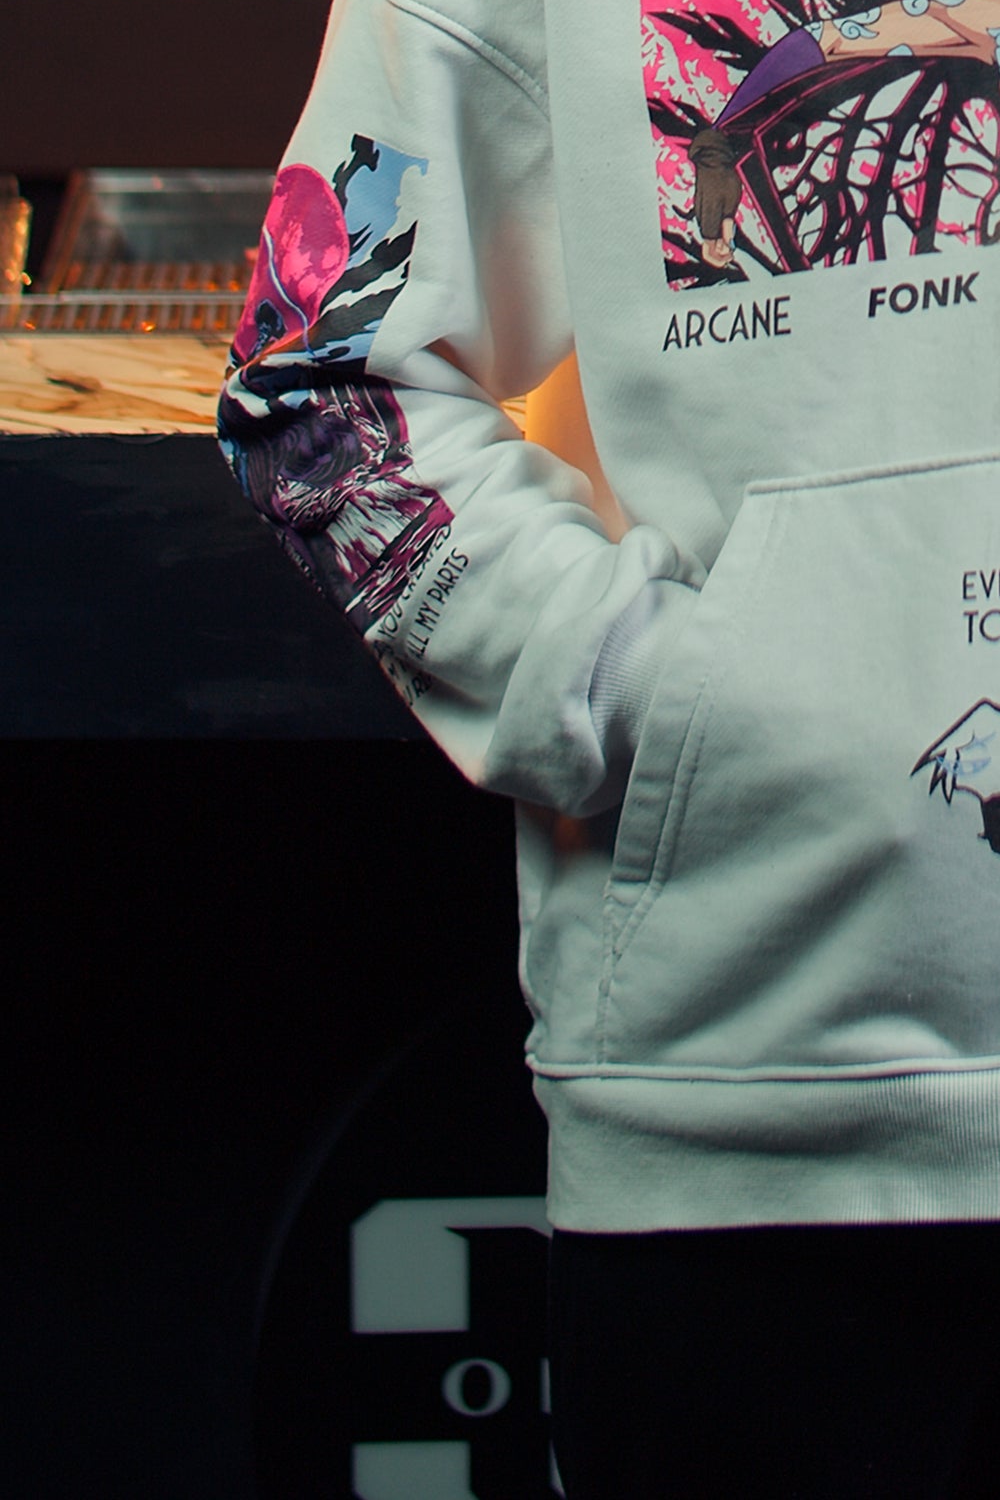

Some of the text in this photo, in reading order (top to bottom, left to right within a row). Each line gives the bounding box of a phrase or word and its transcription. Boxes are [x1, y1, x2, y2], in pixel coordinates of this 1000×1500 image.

[867, 271, 980, 318] FONK
[662, 295, 792, 352] ARCANE
[426, 547, 470, 605] PARTS
[415, 602, 441, 632] MY
